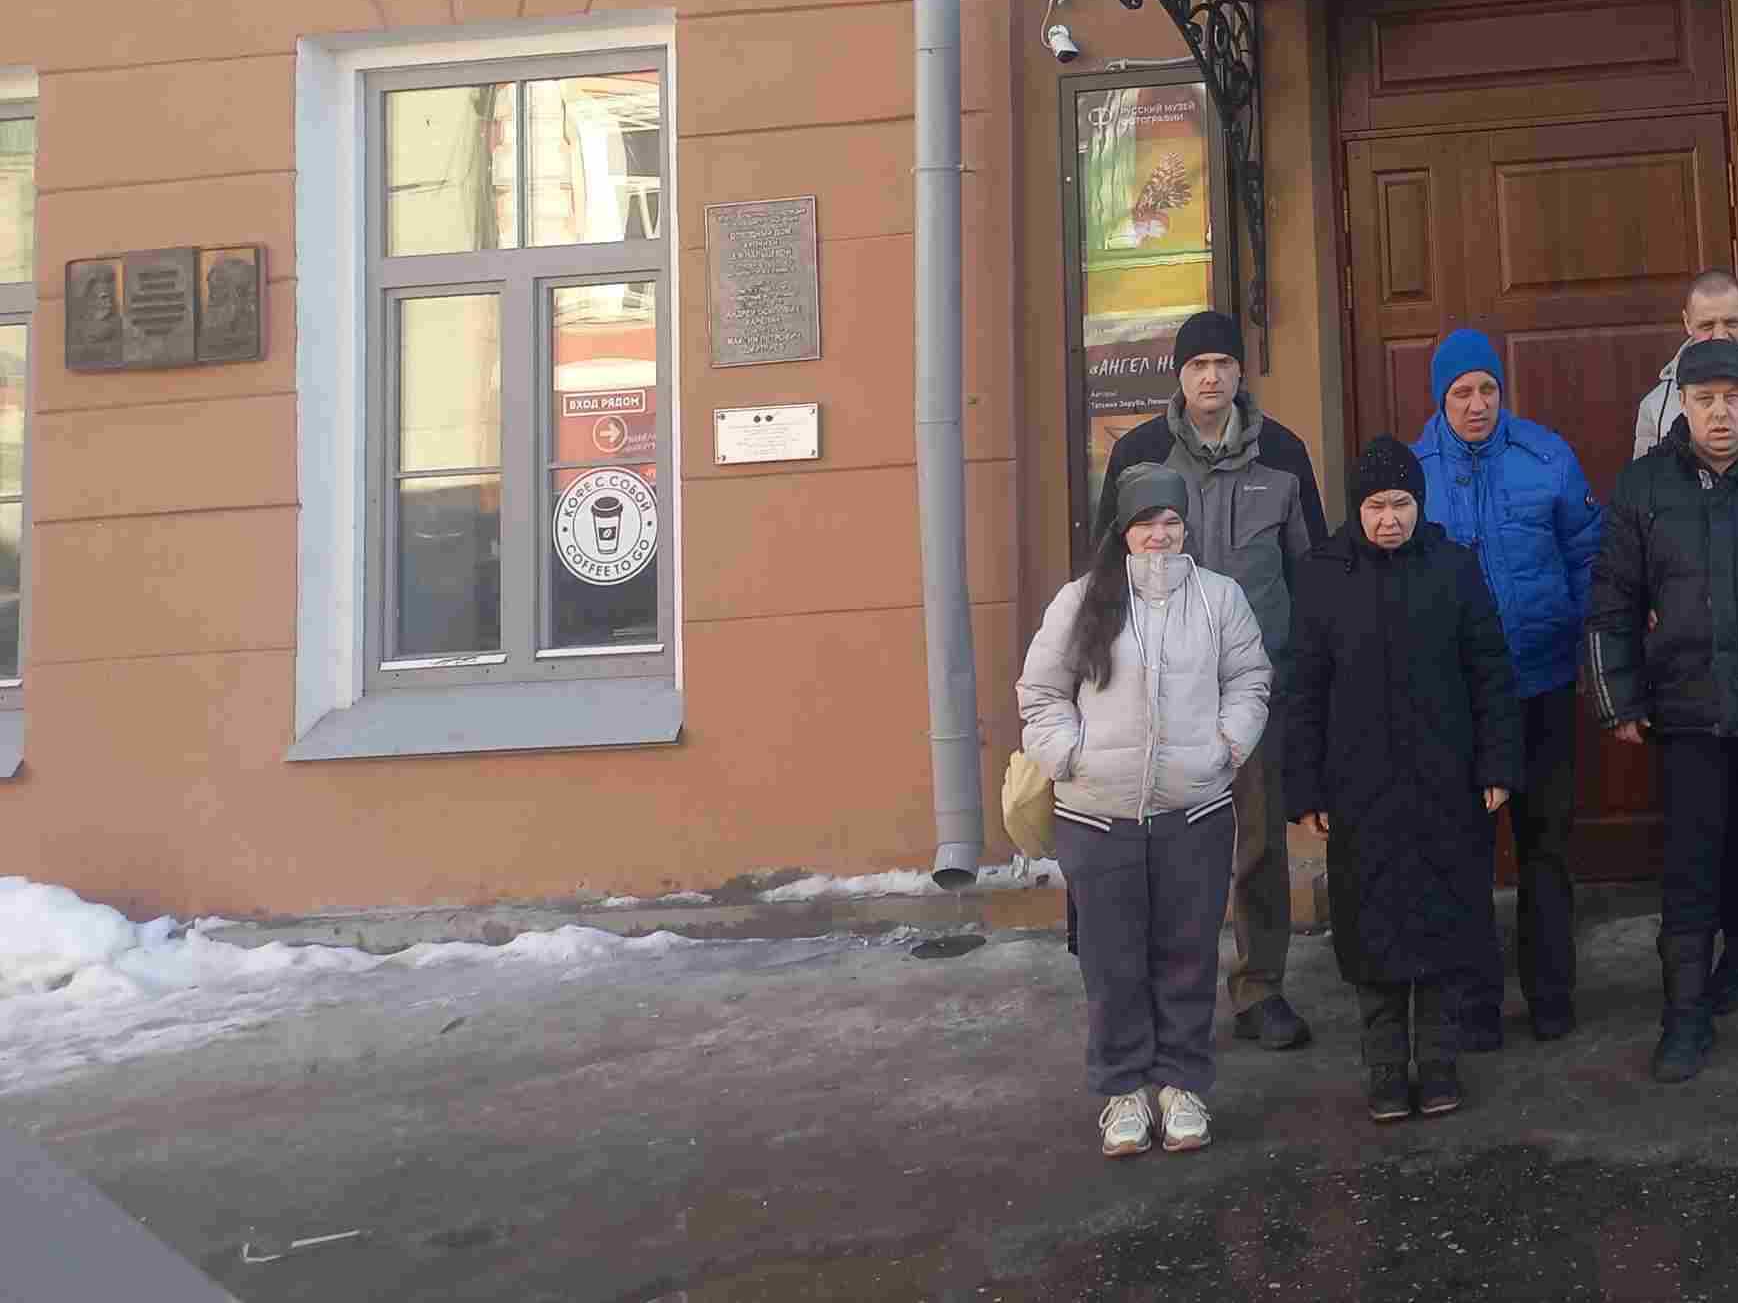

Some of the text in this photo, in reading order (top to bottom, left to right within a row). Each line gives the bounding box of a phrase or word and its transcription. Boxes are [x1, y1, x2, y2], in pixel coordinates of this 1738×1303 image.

[569, 396, 640, 410] ВХОД РЯДОМ
[564, 481, 593, 518] КОФЕ
[608, 475, 652, 512] СОБОЙ
[565, 539, 650, 577] COFFEE TO GO
